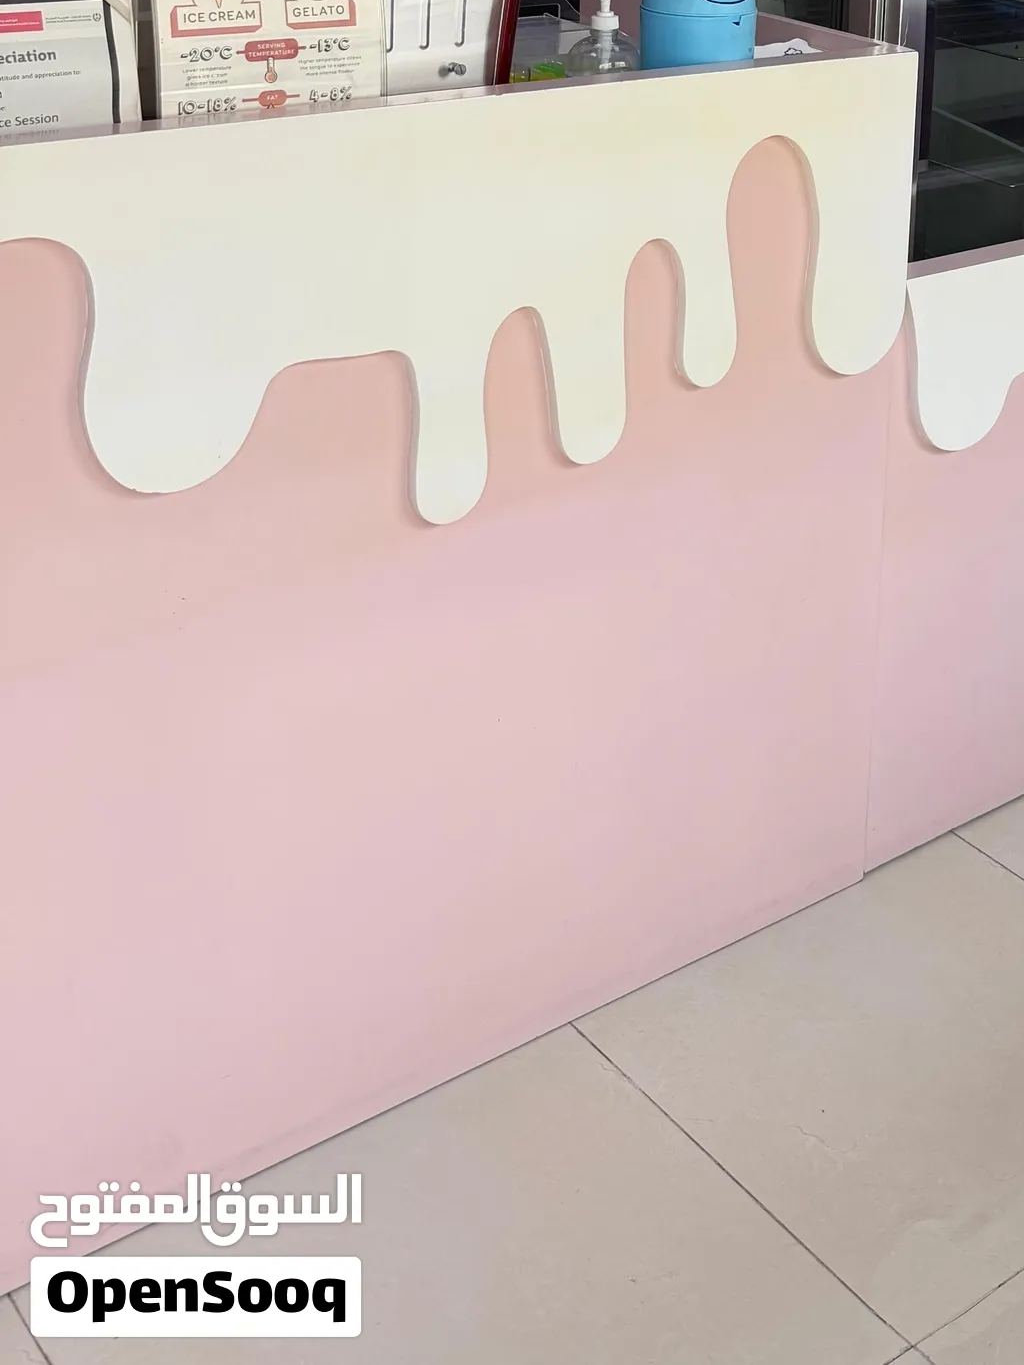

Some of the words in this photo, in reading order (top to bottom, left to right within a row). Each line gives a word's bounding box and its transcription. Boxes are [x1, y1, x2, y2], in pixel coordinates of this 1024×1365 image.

[183, 11, 205, 24] ICE
[208, 9, 256, 22] CREAM
[292, 5, 345, 18] GELATO
[248, 48, 295, 57] TEMPERATURE
[257, 42, 286, 50] SERVING
[35, 71, 72, 80] appreciation
[309, 85, 353, 103] 4-8%
[177, 97, 238, 116] 10-18%
[15, 114, 59, 127] Session
